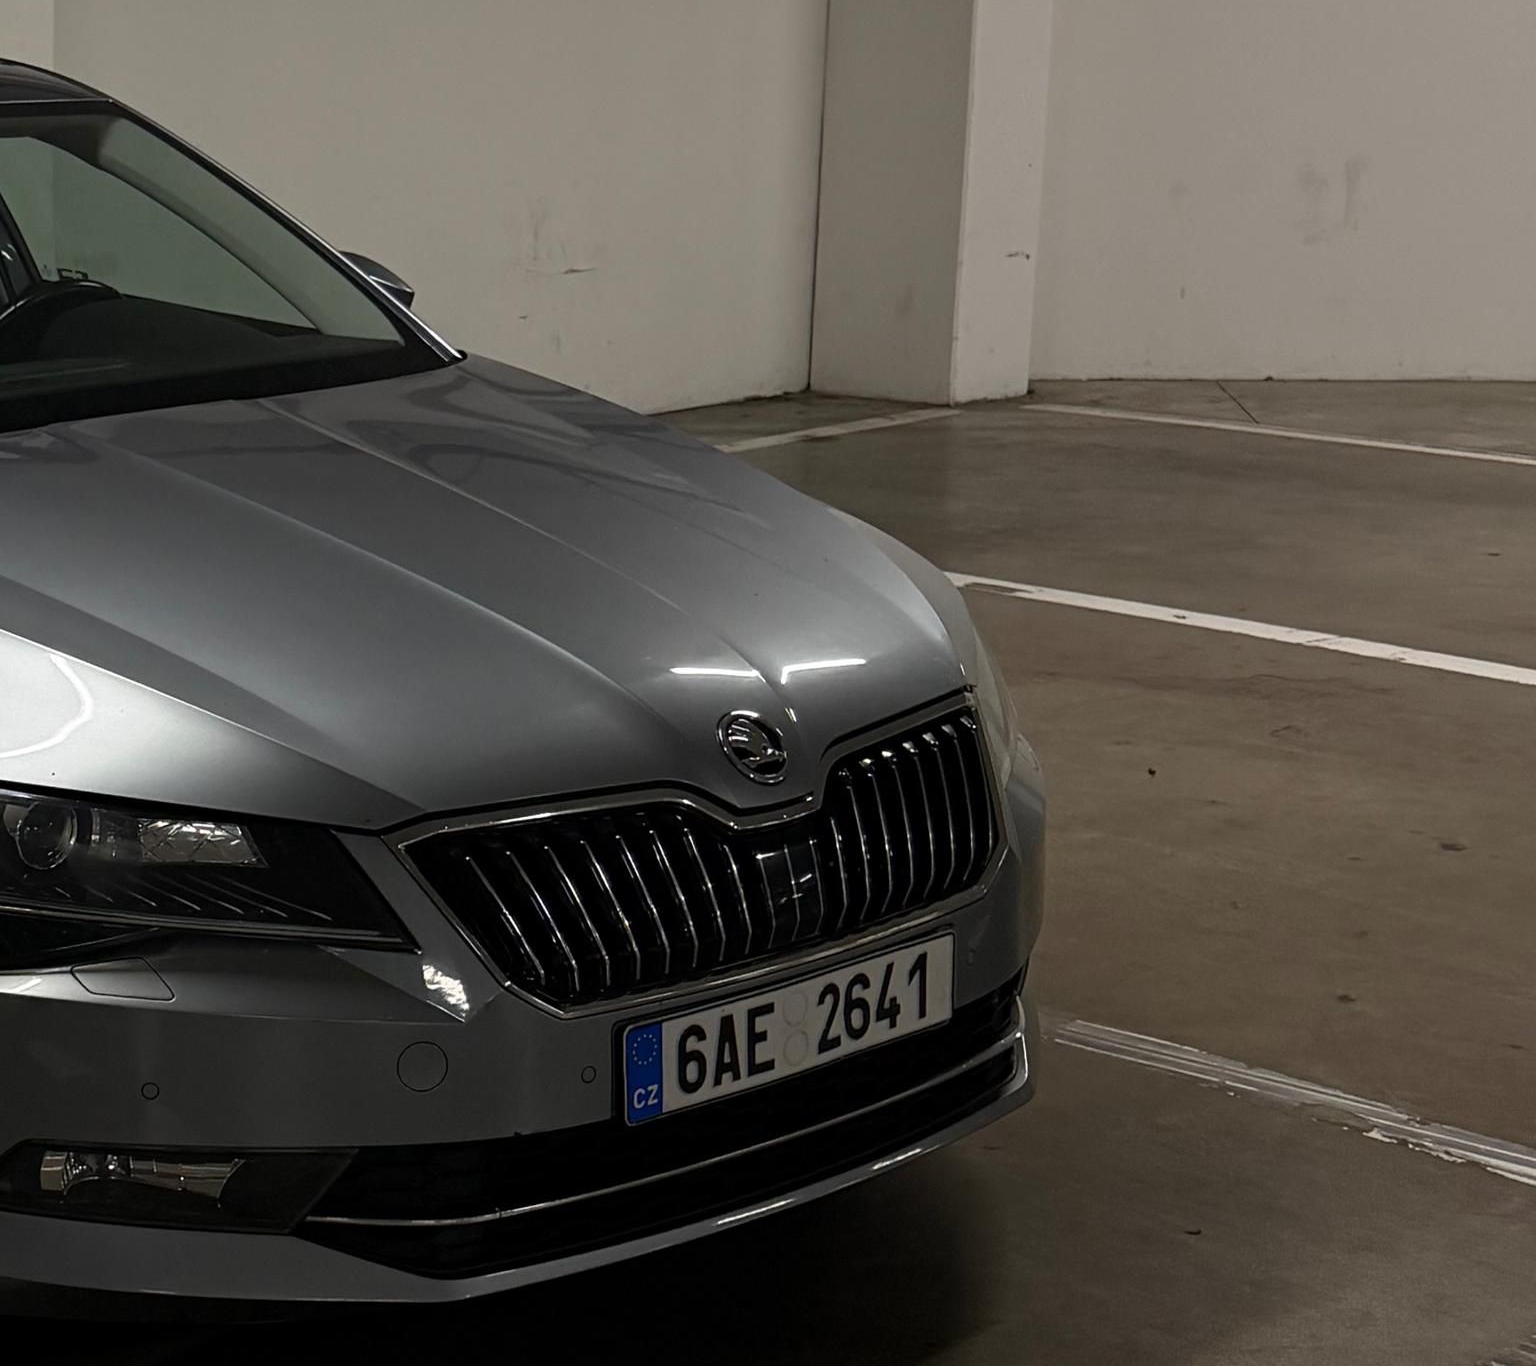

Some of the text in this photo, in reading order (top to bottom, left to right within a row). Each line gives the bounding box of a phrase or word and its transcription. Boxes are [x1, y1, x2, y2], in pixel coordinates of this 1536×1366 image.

[678, 952, 928, 1094] 6AE 2641
[632, 1084, 659, 1110] CZ
